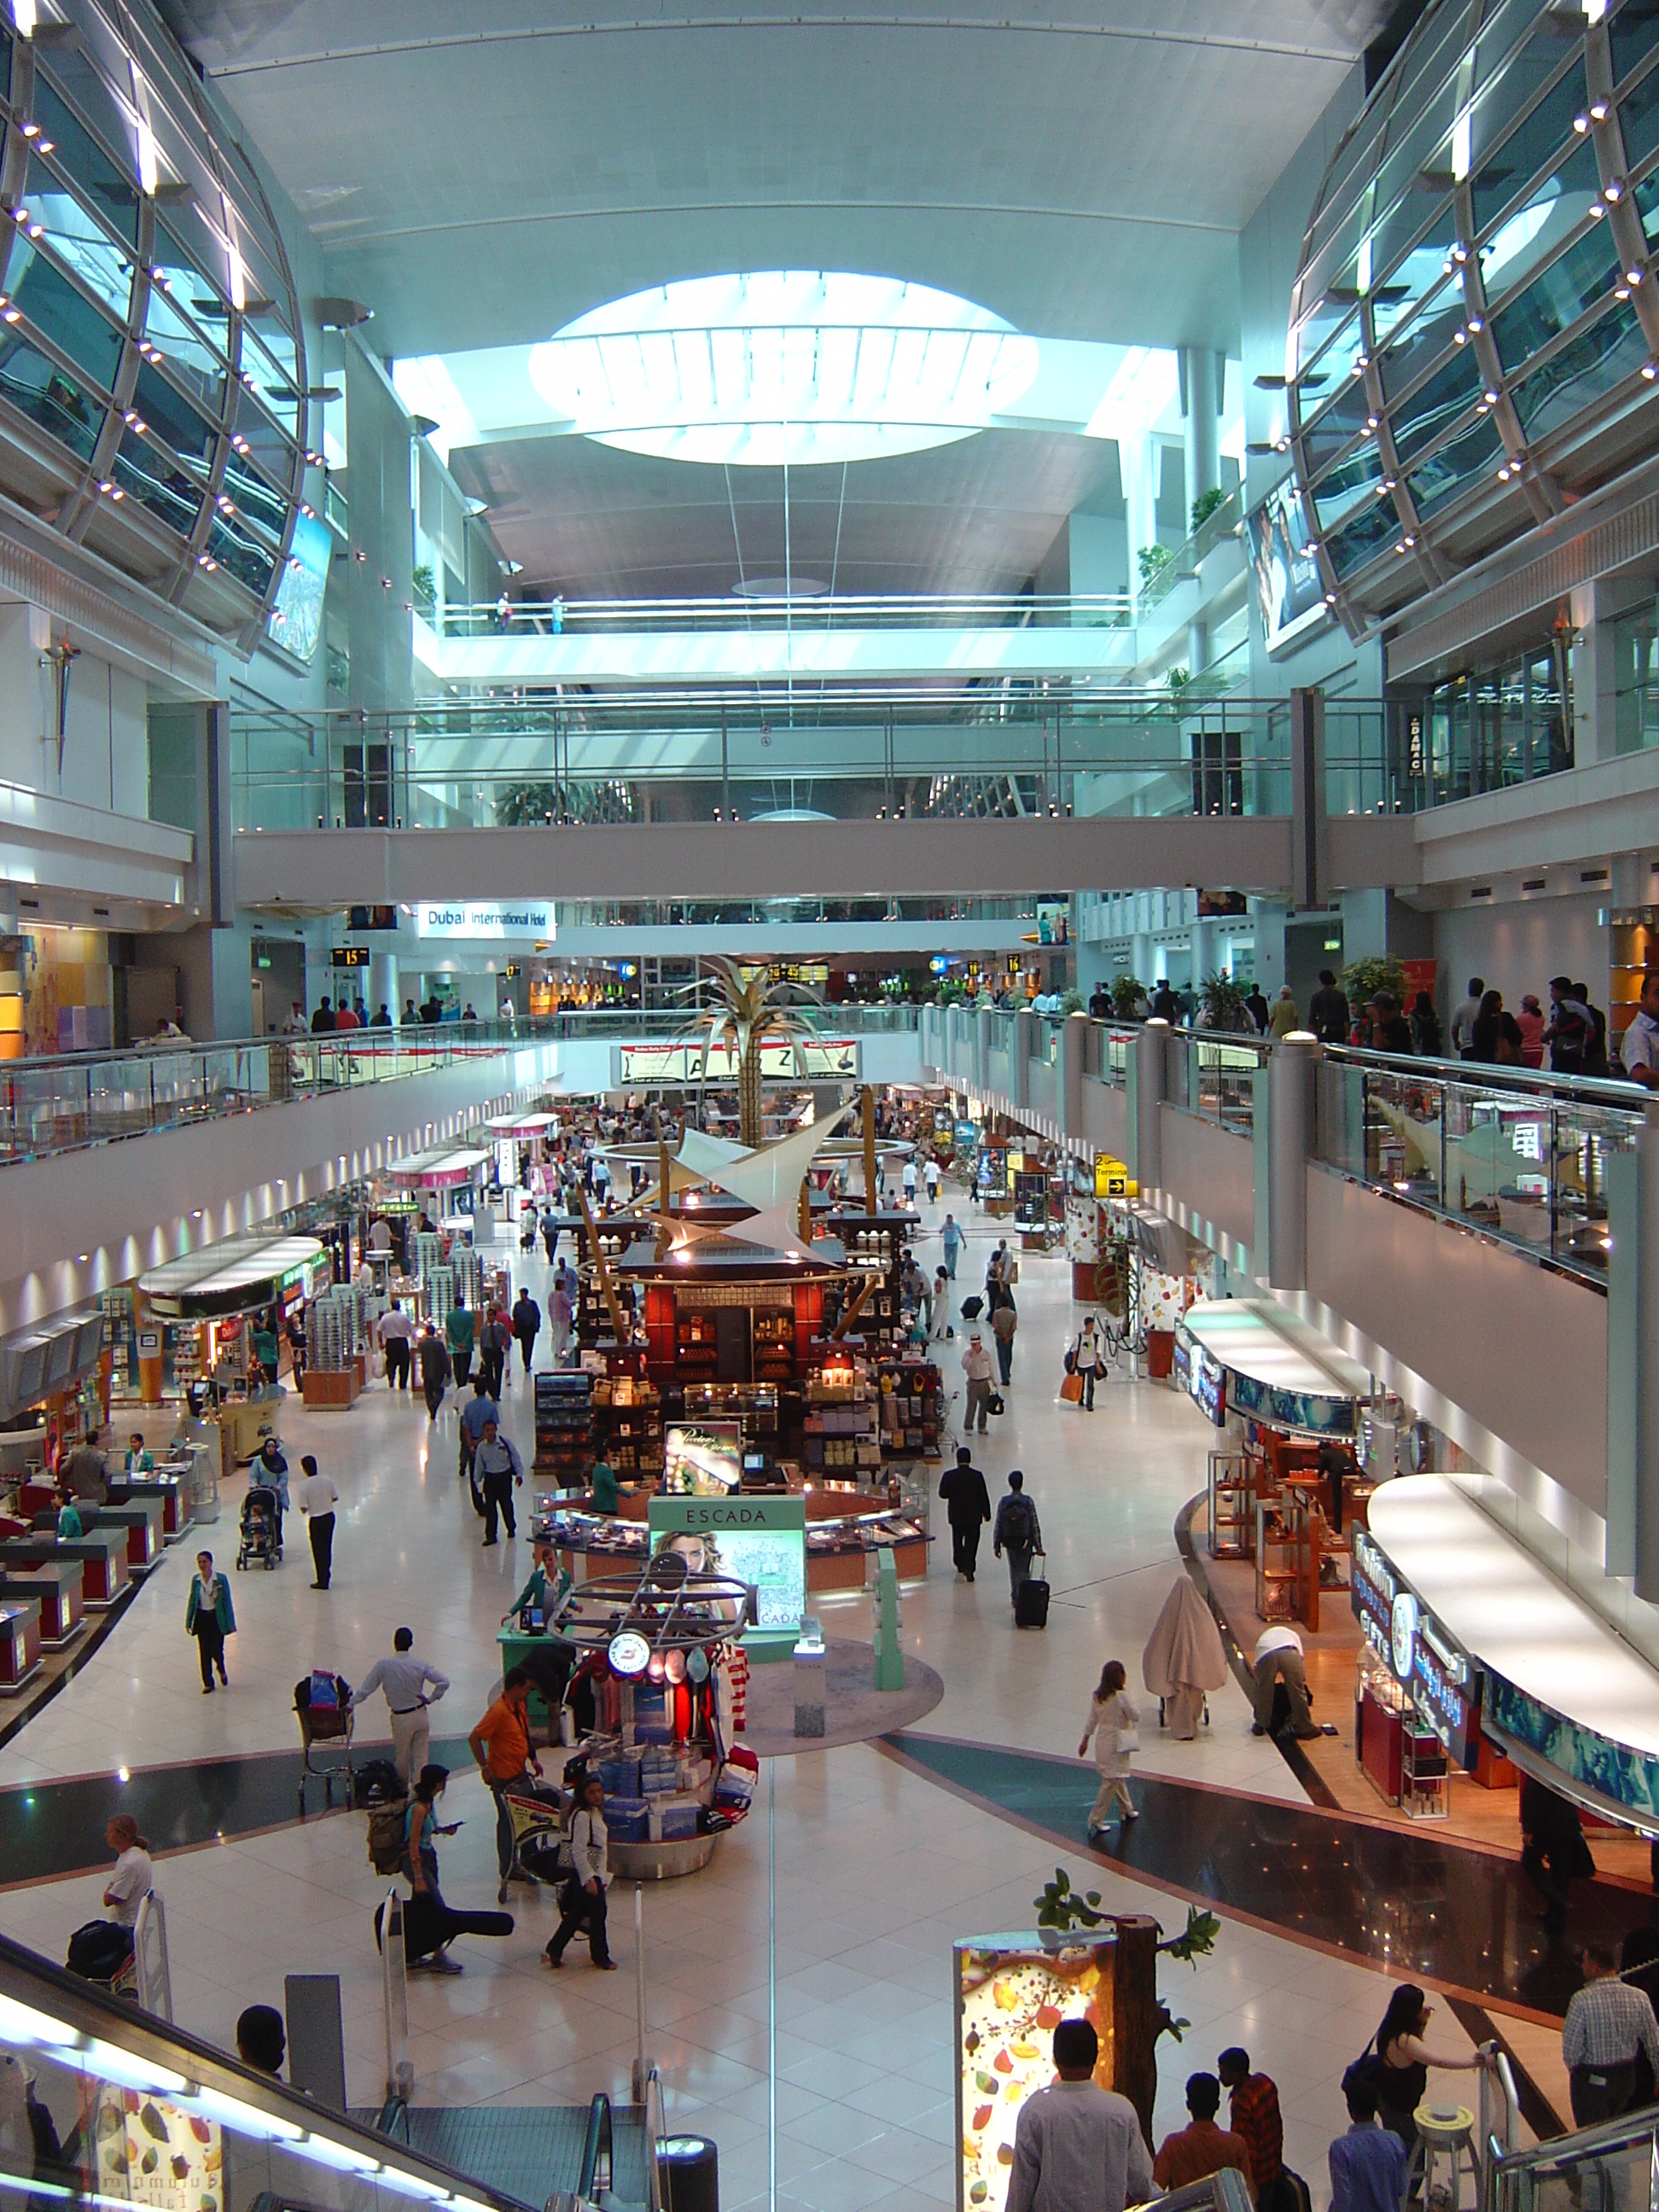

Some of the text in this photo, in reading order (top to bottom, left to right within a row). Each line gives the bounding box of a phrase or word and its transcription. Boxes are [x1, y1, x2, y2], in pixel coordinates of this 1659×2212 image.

[1411, 726, 1421, 769] DAMAC
[428, 911, 546, 926] Dubai International Hotel
[346, 950, 358, 964] 15
[1009, 958, 1019, 972] 16
[778, 1050, 792, 1067] Z
[1096, 1156, 1103, 1166] 2
[686, 1509, 766, 1523] ESCADA
[761, 1614, 800, 1624] CADA
[1360, 1609, 1391, 1664] GIFTS
